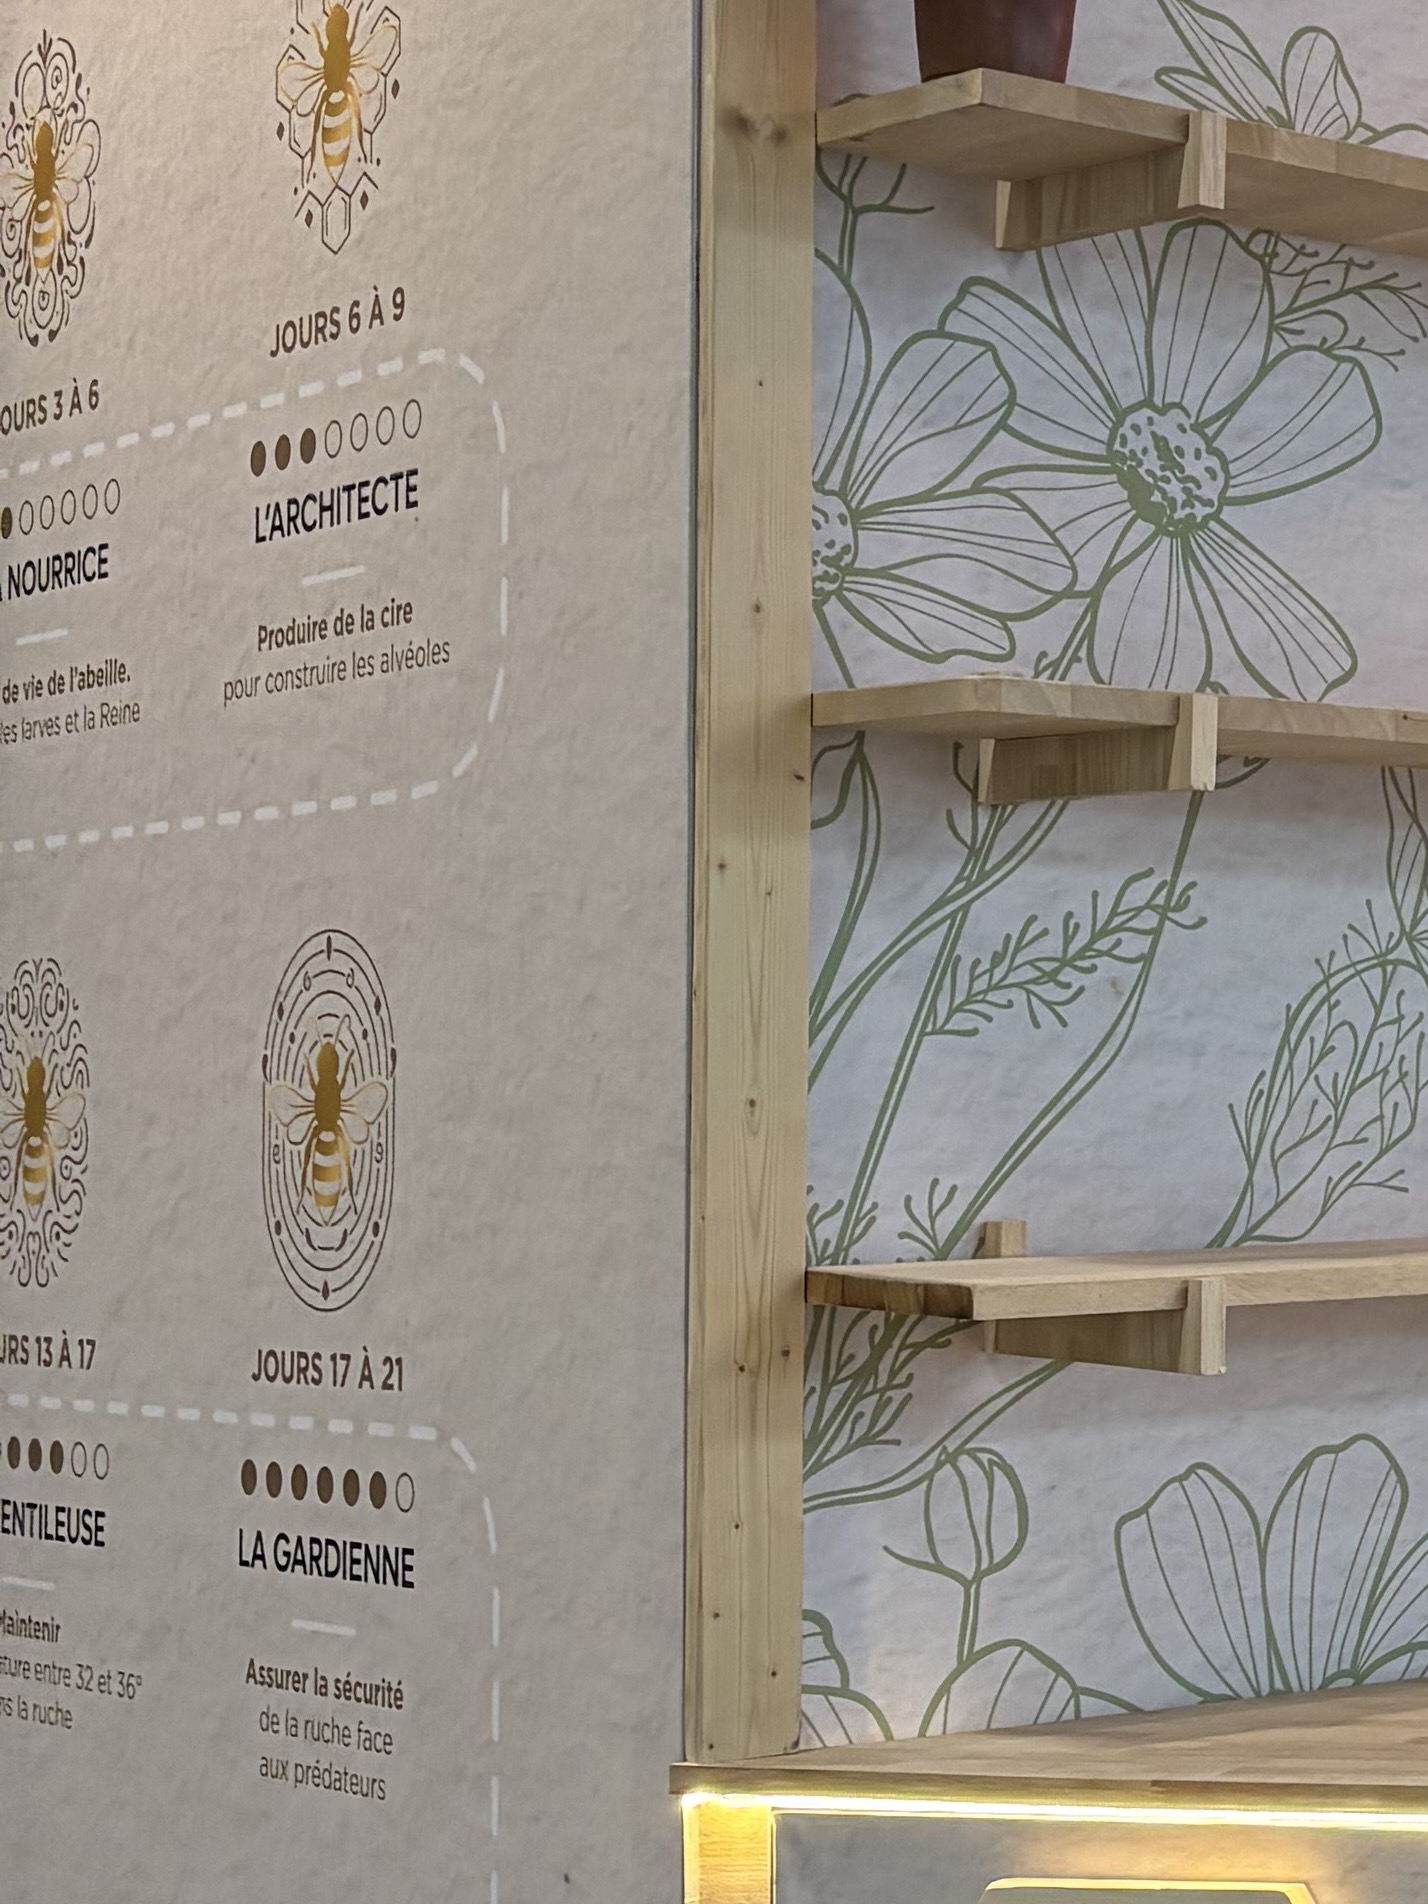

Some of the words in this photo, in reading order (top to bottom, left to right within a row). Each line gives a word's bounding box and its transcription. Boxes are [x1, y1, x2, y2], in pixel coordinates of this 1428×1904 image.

[270, 306, 341, 358] JOURS
[349, 300, 361, 334] 6
[368, 285, 384, 329] À
[392, 286, 405, 322] 9
[53, 389, 63, 421] 3
[69, 377, 82, 418] À
[88, 379, 100, 411] 6
[255, 468, 419, 544] L'ARCHITECTE
[8, 543, 109, 600] NOURRICE
[257, 614, 328, 652] Produire
[333, 607, 355, 637] de
[360, 603, 375, 633] la
[381, 597, 413, 628] cire
[2, 678, 19, 704] de
[22, 674, 43, 701] vie
[48, 669, 65, 696] de
[70, 658, 131, 693] l'abeille.
[223, 674, 260, 708] pour
[265, 656, 347, 695] construire
[352, 651, 374, 680] les
[380, 637, 450, 674] alvéoles
[21, 716, 61, 743] larves
[65, 709, 80, 734] et
[83, 704, 96, 732] la
[100, 700, 140, 729] Reine
[35, 1336, 53, 1368] 13
[58, 1329, 72, 1370] À
[78, 1338, 96, 1371] 17
[251, 1348, 323, 1386] JOURS
[329, 1352, 352, 1388] 17
[358, 1345, 375, 1390] À
[381, 1355, 403, 1392] 21
[0, 1498, 106, 1548] ENTILEUSE
[239, 1527, 268, 1571] LA
[273, 1532, 415, 1589] GARDIENNE
[34, 1660, 71, 1688] entre
[75, 1663, 94, 1692] 32
[97, 1669, 113, 1695] et
[245, 1657, 309, 1695] Assurer
[314, 1666, 329, 1697] la
[333, 1671, 404, 1711] sécurité
[17, 1696, 29, 1722] la
[32, 1700, 74, 1730] ruche
[259, 1704, 280, 1735] de
[285, 1707, 299, 1738] la
[304, 1716, 352, 1748] ruche
[356, 1720, 394, 1756] face
[259, 1755, 289, 1782] aux
[294, 1759, 387, 1802] prédateurs
